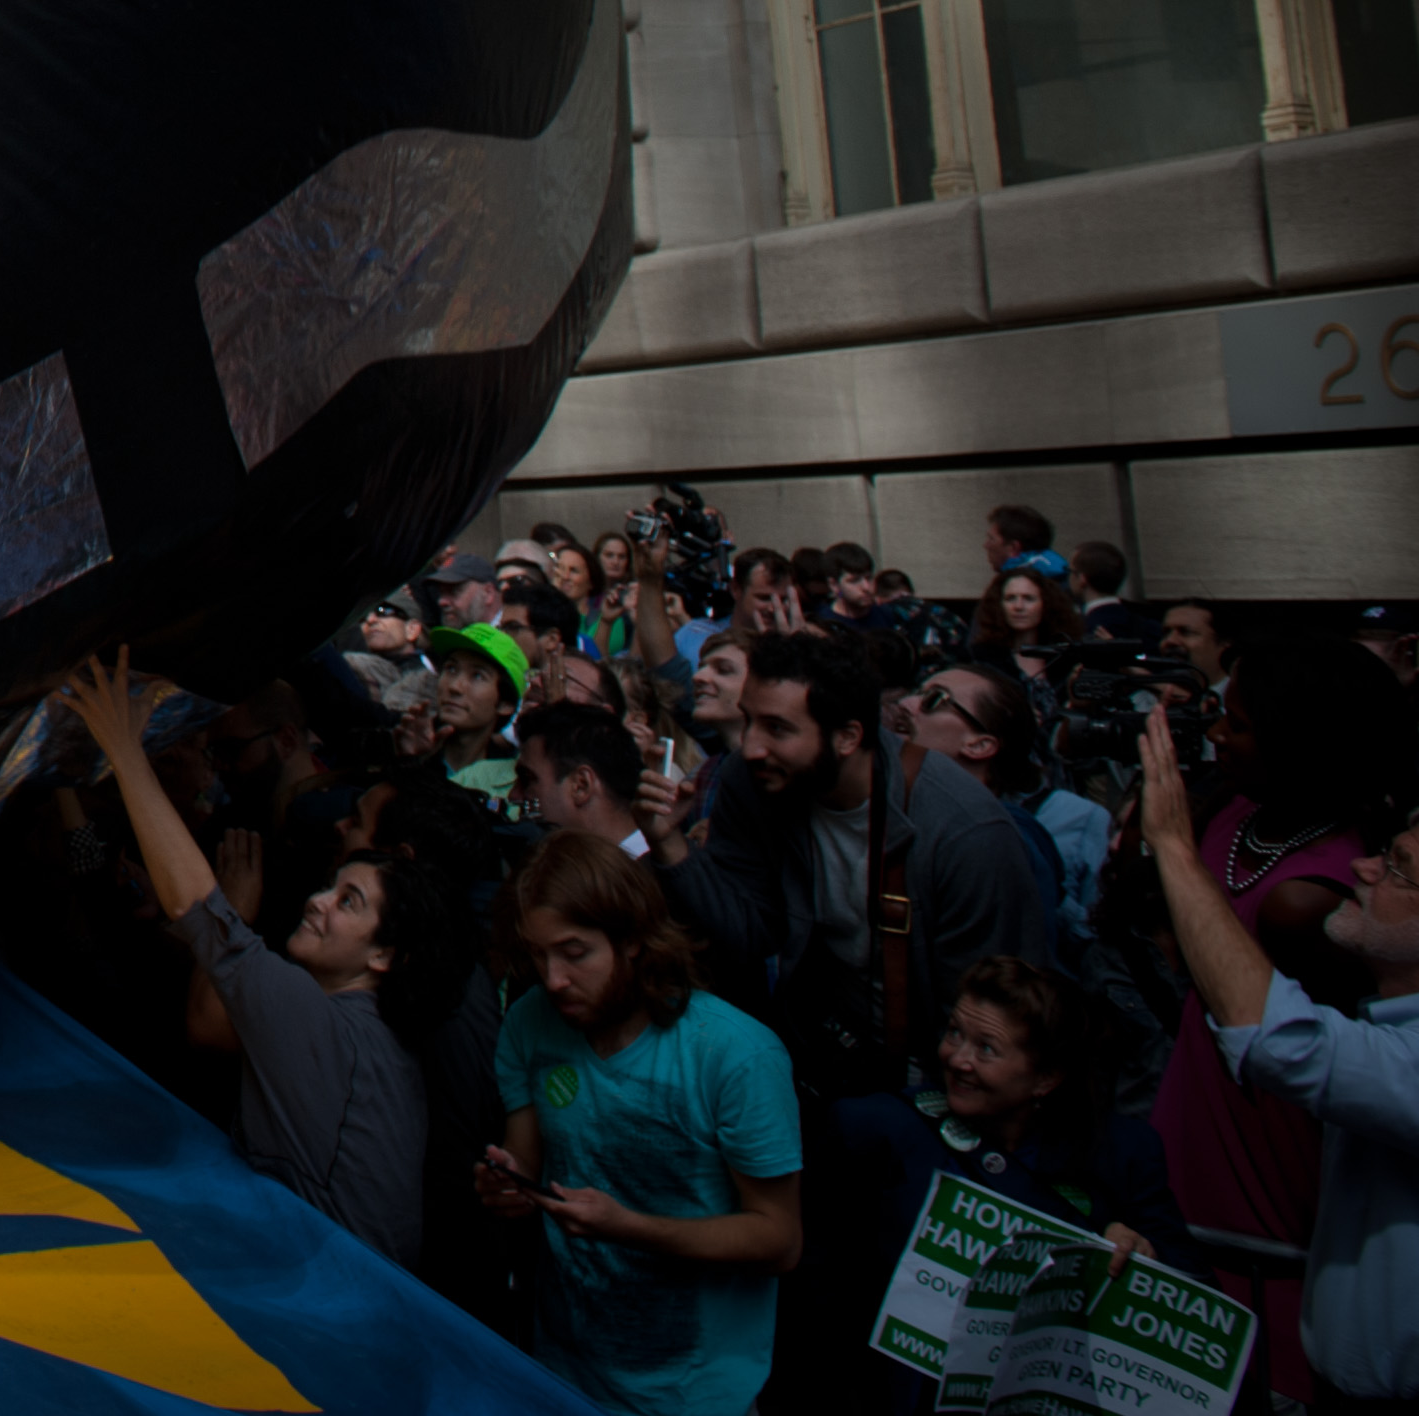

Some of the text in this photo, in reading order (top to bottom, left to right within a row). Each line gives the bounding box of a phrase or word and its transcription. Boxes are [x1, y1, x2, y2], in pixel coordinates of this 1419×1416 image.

[1126, 1268, 1238, 1336] BRIAN
[1112, 1305, 1230, 1371] JONES
[1066, 1364, 1152, 1408] PARTY
[1092, 1347, 1211, 1410] GOVERNOR
